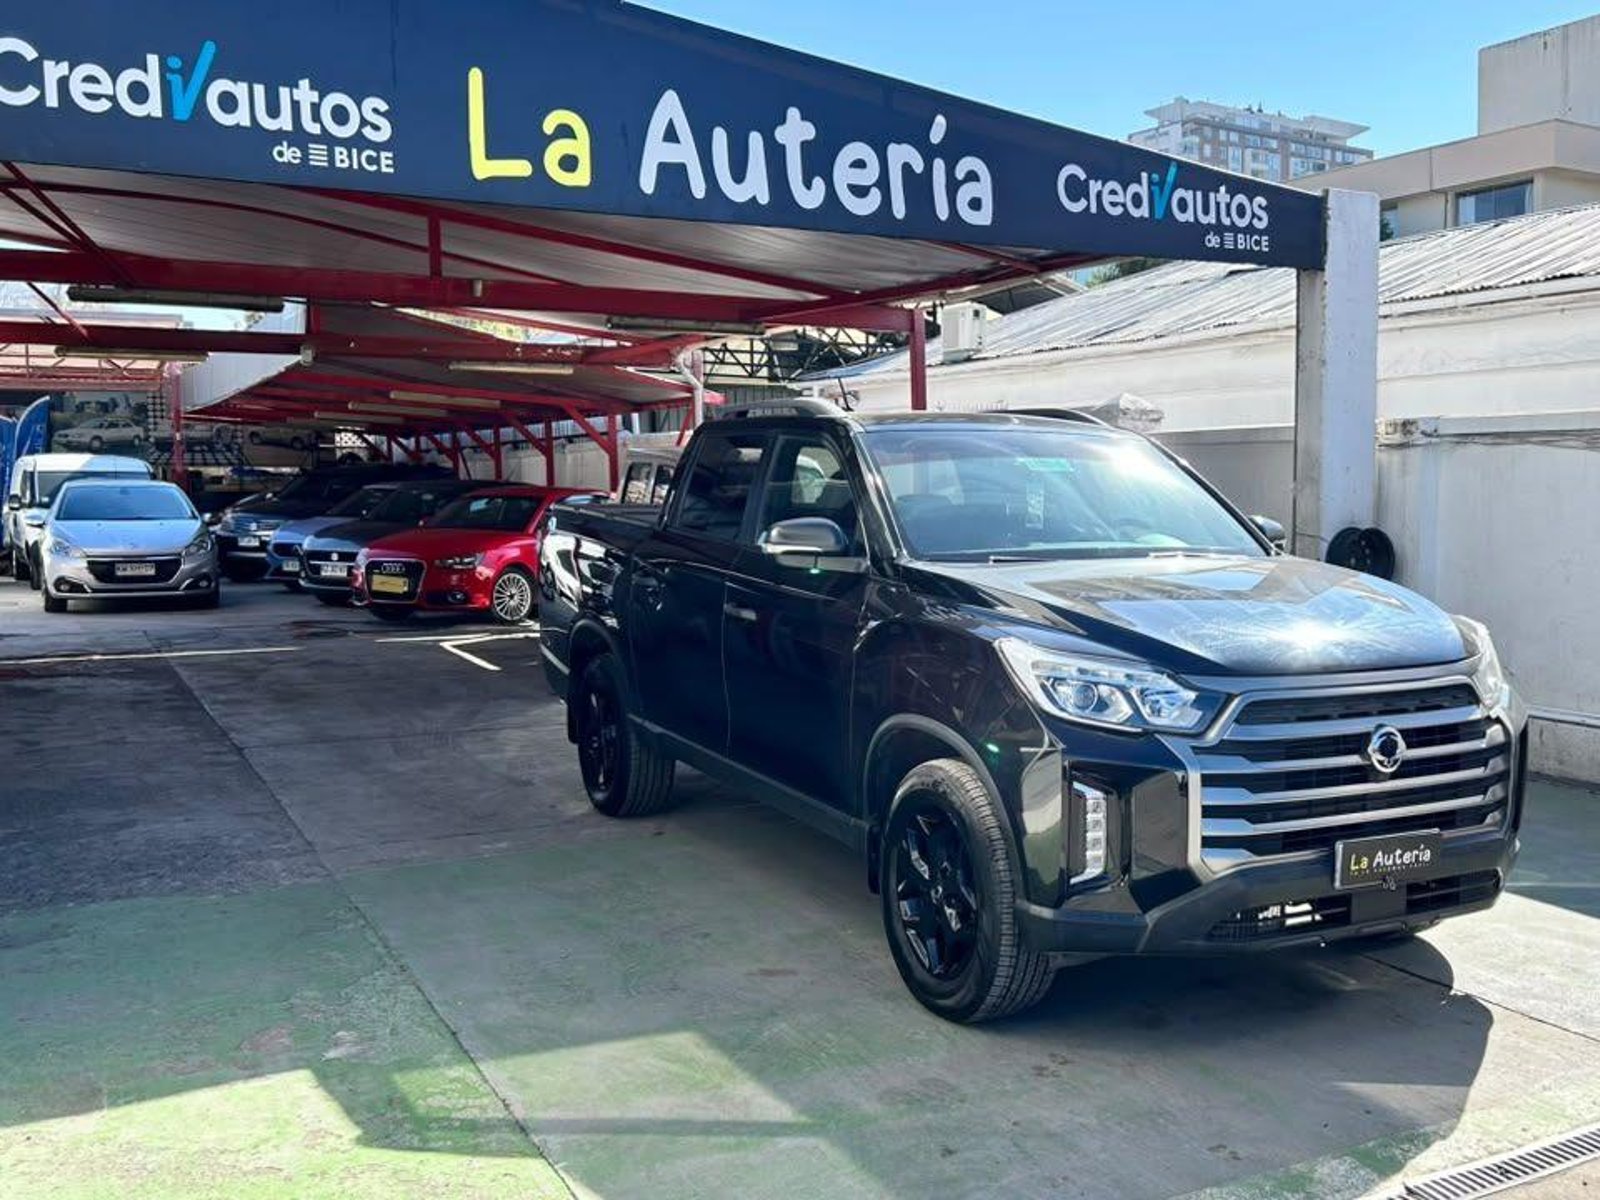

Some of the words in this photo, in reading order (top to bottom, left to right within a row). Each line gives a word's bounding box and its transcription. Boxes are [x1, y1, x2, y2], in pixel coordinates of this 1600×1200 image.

[272, 141, 301, 164] de
[333, 146, 394, 174] BICE
[467, 66, 592, 187] La
[639, 88, 994, 226] Autería
[1204, 231, 1221, 249] de
[1237, 233, 1270, 252] BICE
[1350, 853, 1369, 870] La
[1372, 843, 1431, 868] Autería
